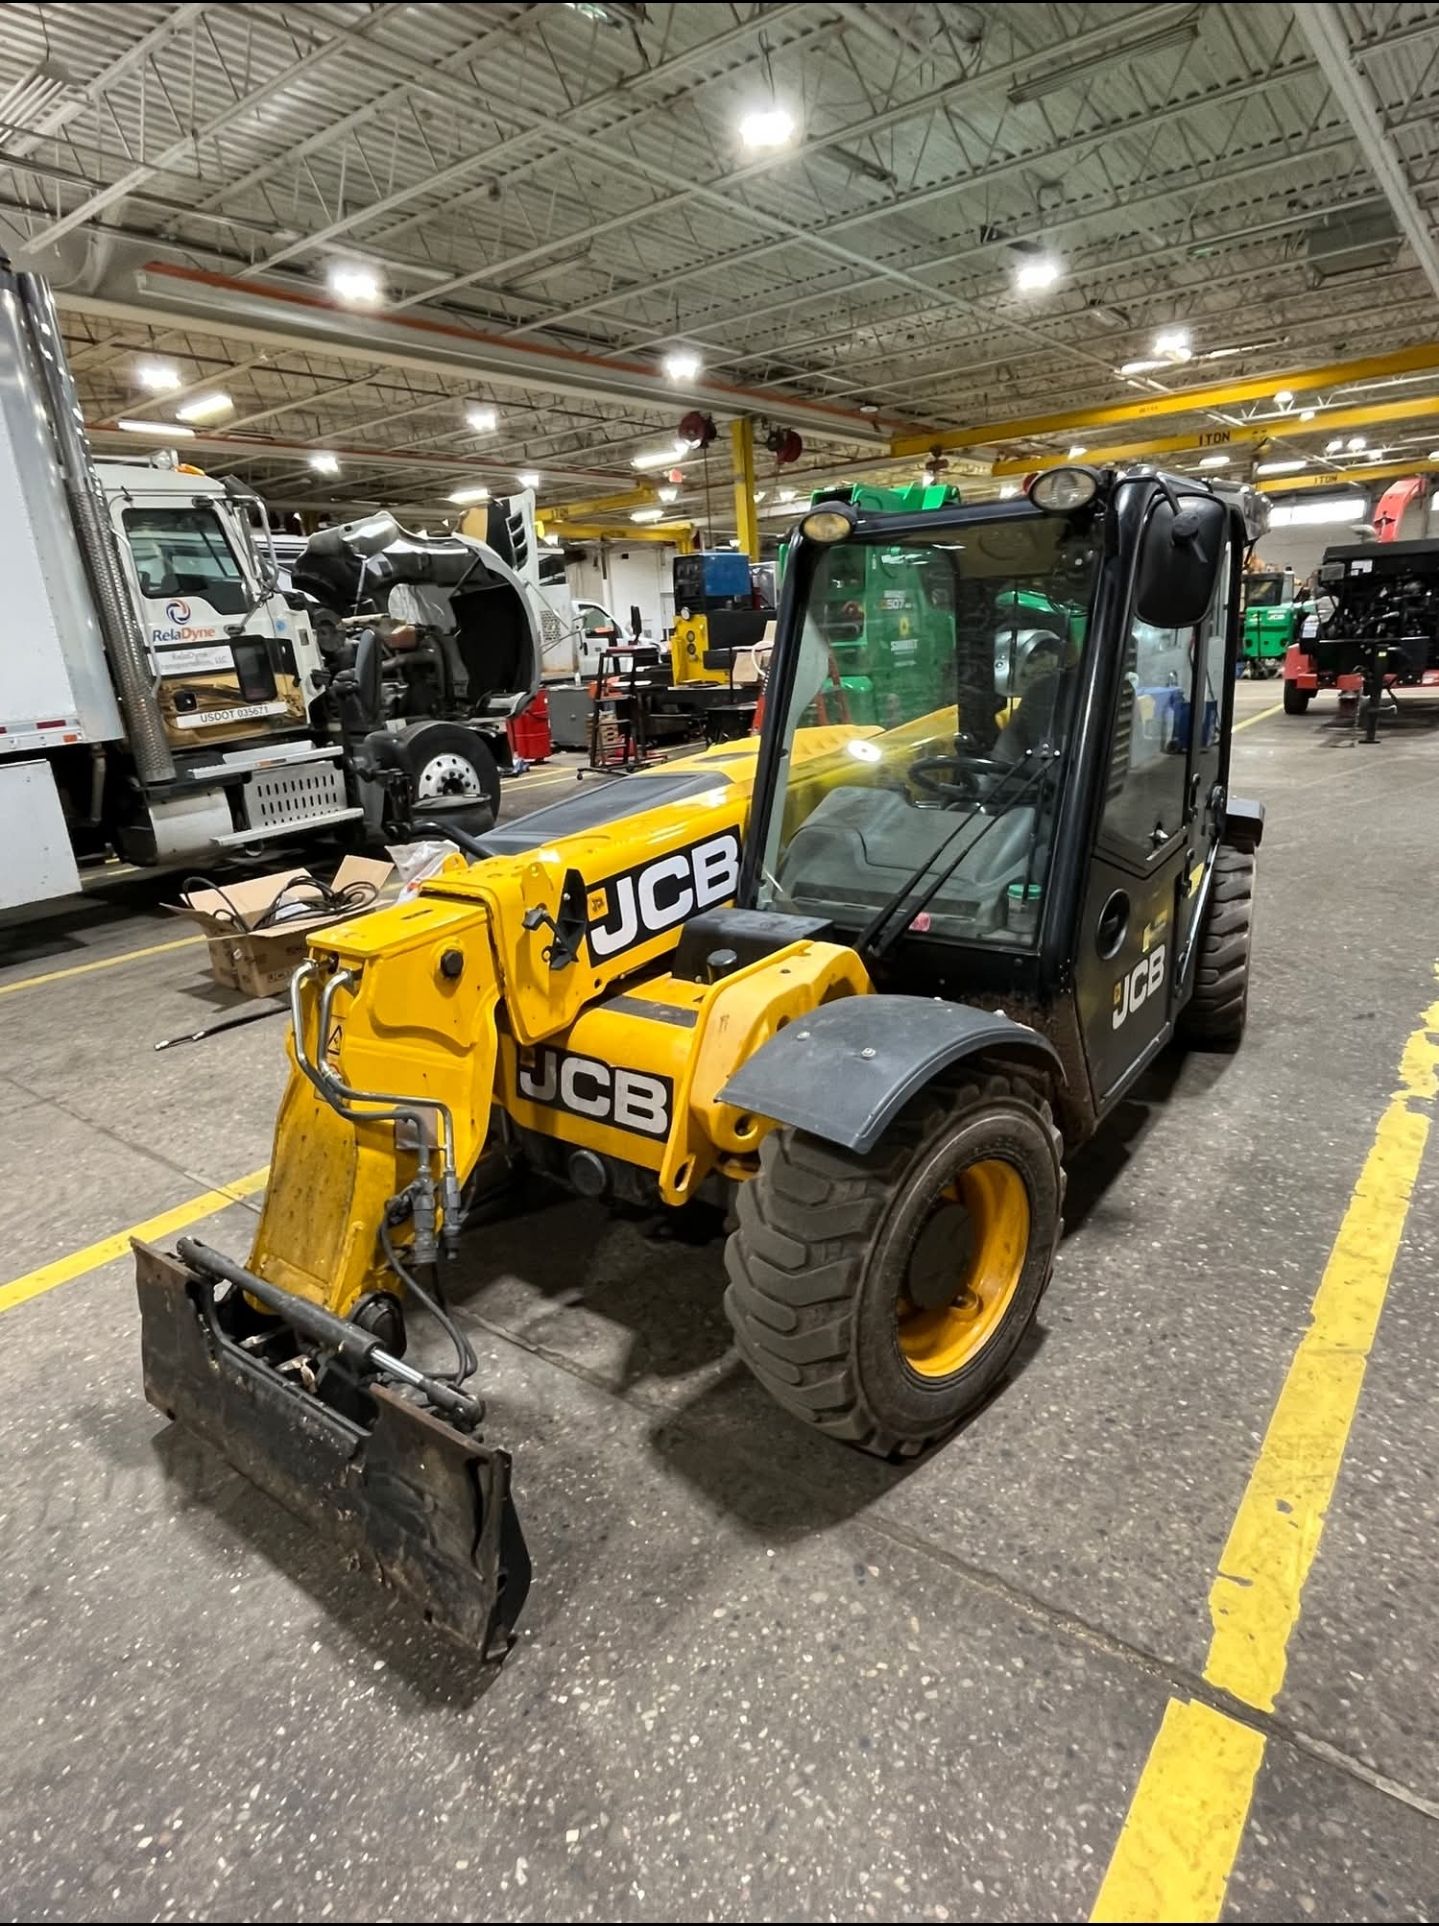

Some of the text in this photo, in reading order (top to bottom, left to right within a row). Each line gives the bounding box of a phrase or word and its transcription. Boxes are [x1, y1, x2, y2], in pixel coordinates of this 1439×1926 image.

[1206, 431, 1231, 445] TON
[152, 627, 216, 642] RelaDyne
[200, 711, 234, 723] USDOT
[590, 835, 738, 955] JCB
[1112, 943, 1166, 1031] JCB
[519, 1050, 668, 1134] JCB
